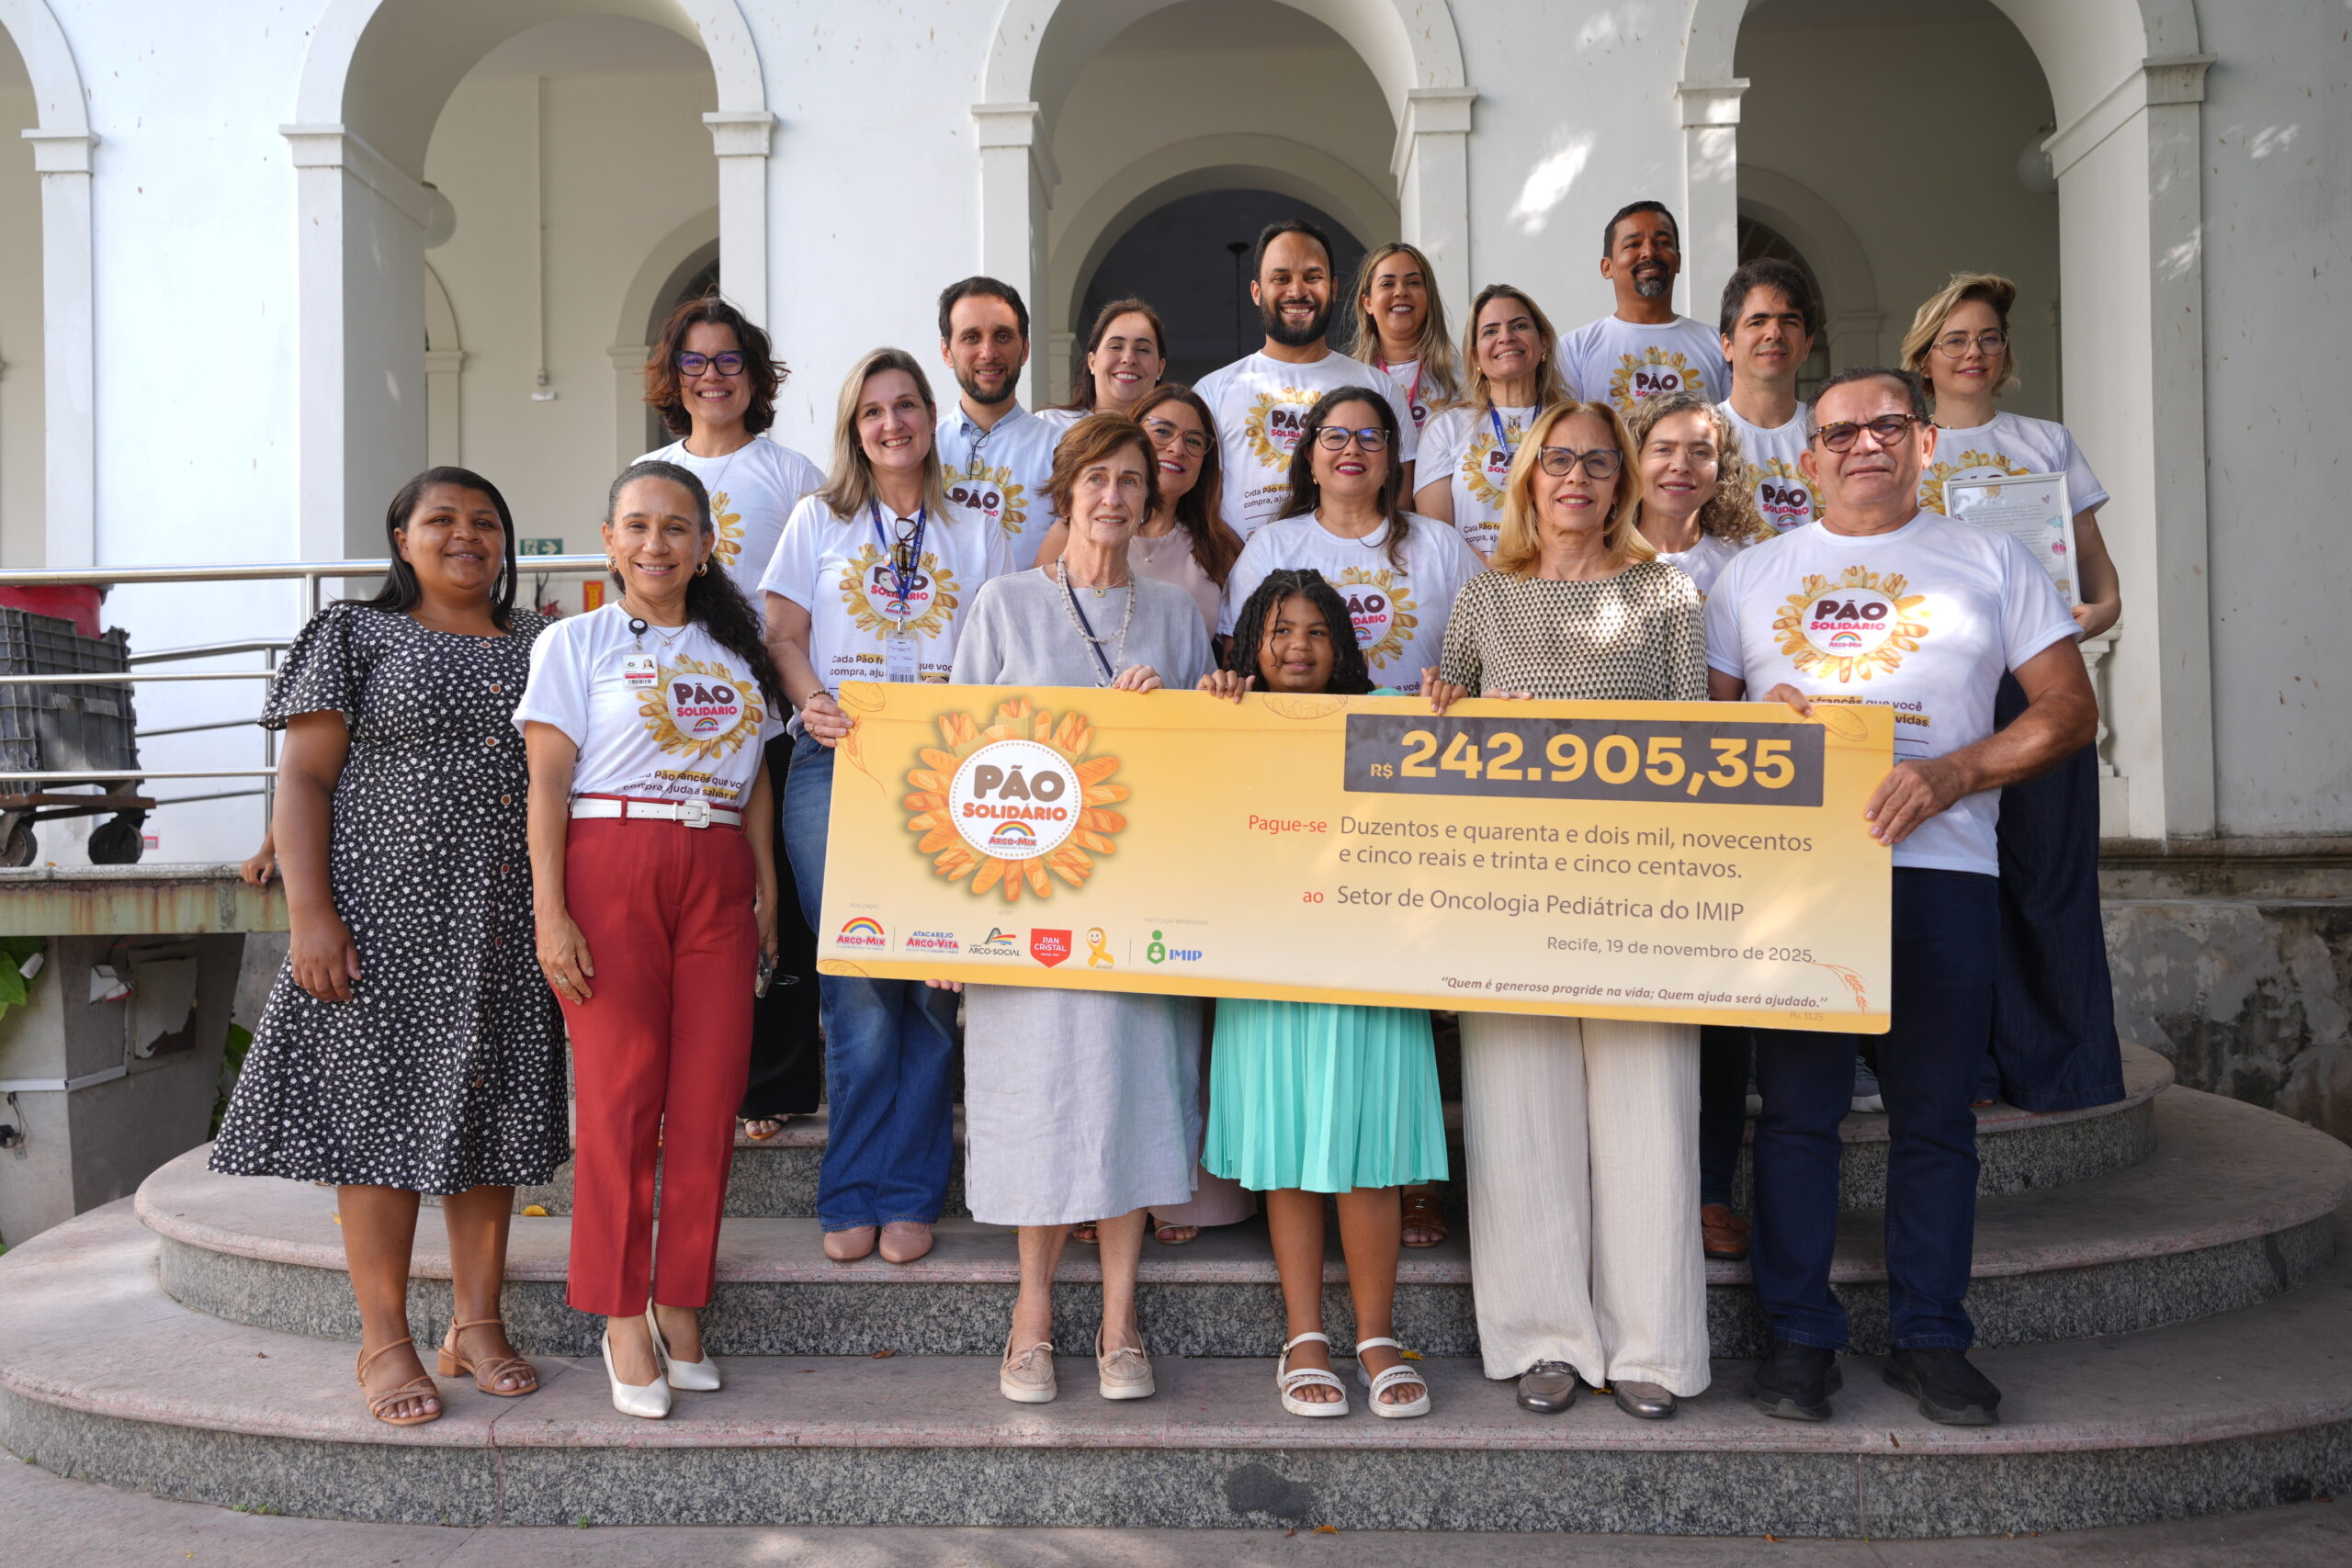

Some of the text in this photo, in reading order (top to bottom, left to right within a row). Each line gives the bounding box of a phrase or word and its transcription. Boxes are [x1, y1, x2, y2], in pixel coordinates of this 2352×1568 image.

[1636, 372, 1679, 391] PÃO
[1761, 484, 1807, 507] PÃO
[1815, 600, 1888, 621] PÃO
[1810, 621, 1886, 631] SOLIDÁRIO
[855, 655, 875, 664] Pão
[830, 668, 884, 678] compra, aju
[673, 682, 735, 705] PÃO
[677, 705, 737, 717] SOLIDÁRIO
[1894, 701, 1923, 712] você
[1371, 729, 1795, 796] R$ 242.905,35
[654, 770, 675, 781] Pão
[973, 764, 1066, 802] PÃO
[963, 802, 1068, 822] SOLIDÁRIO
[1249, 815, 1813, 852] Pague-se Duzentos e quarenta e dois mil, novecentos
[1339, 845, 1742, 878] e cinco reais e trinta e cinco centavos.
[1303, 886, 1744, 922] ao Setor de Oncologia Pediátrica do IMIP
[837, 935, 886, 946] ARCO-MIX
[906, 937, 959, 949] ARCO-VITA
[912, 931, 954, 939] ATACAREJO
[1170, 949, 1203, 961] IMIP
[1547, 936, 1816, 963] Recife, 19 de novembro de 2025.
[1486, 979, 1493, 989] é
[1495, 981, 1550, 993] generoso
[1552, 982, 1603, 996] progride
[1607, 987, 1622, 997] na
[1625, 987, 1655, 999] vida;
[1658, 988, 1694, 1001] Quem
[1697, 990, 1732, 1004] ajuda
[1736, 993, 1762, 1005] será
